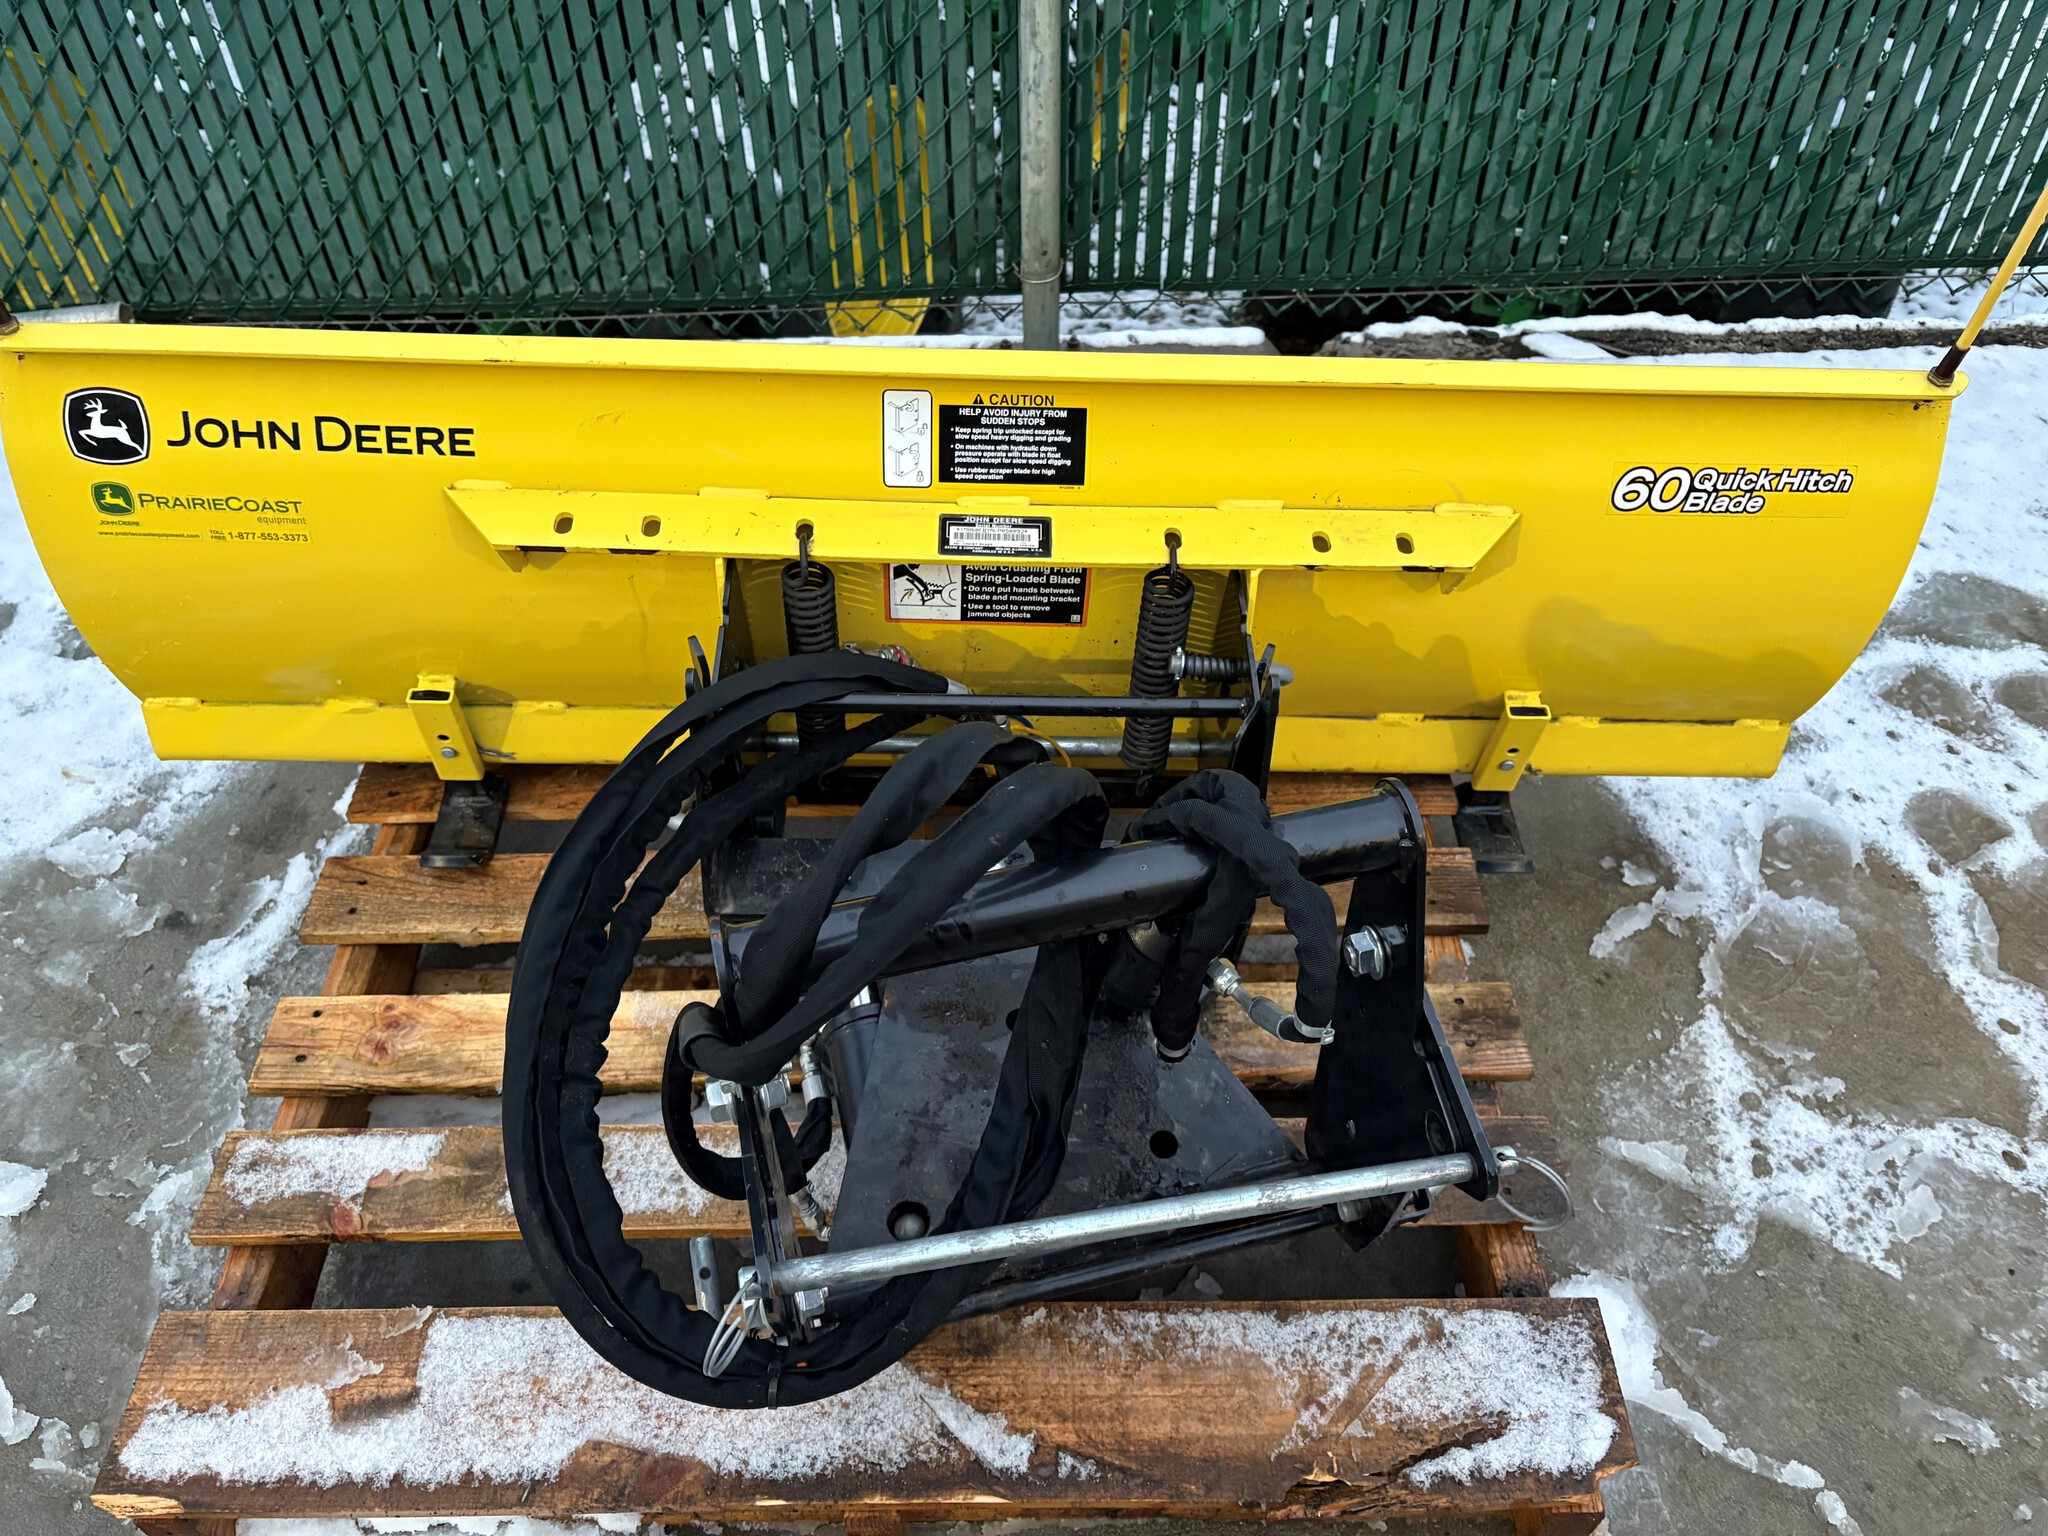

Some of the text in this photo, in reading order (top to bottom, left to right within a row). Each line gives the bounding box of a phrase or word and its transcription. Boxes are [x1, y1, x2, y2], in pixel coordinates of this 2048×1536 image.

[990, 394, 1054, 406] CAUTION
[959, 408, 1067, 418] HELP AVOID INJURY FROM
[981, 417, 1015, 425] SUDDEN
[167, 411, 476, 457] JOHN DEERE
[1612, 466, 1693, 512] 60
[1681, 492, 1765, 513] Blade
[257, 516, 306, 526] equipment
[228, 532, 308, 542] 1-877-553-3373
[965, 573, 1080, 584] Spring-Loaded Blade
[968, 593, 991, 601] blade
[1010, 594, 1048, 602] mounting
[1050, 595, 1080, 603] bracket
[1002, 611, 1031, 619] objects
